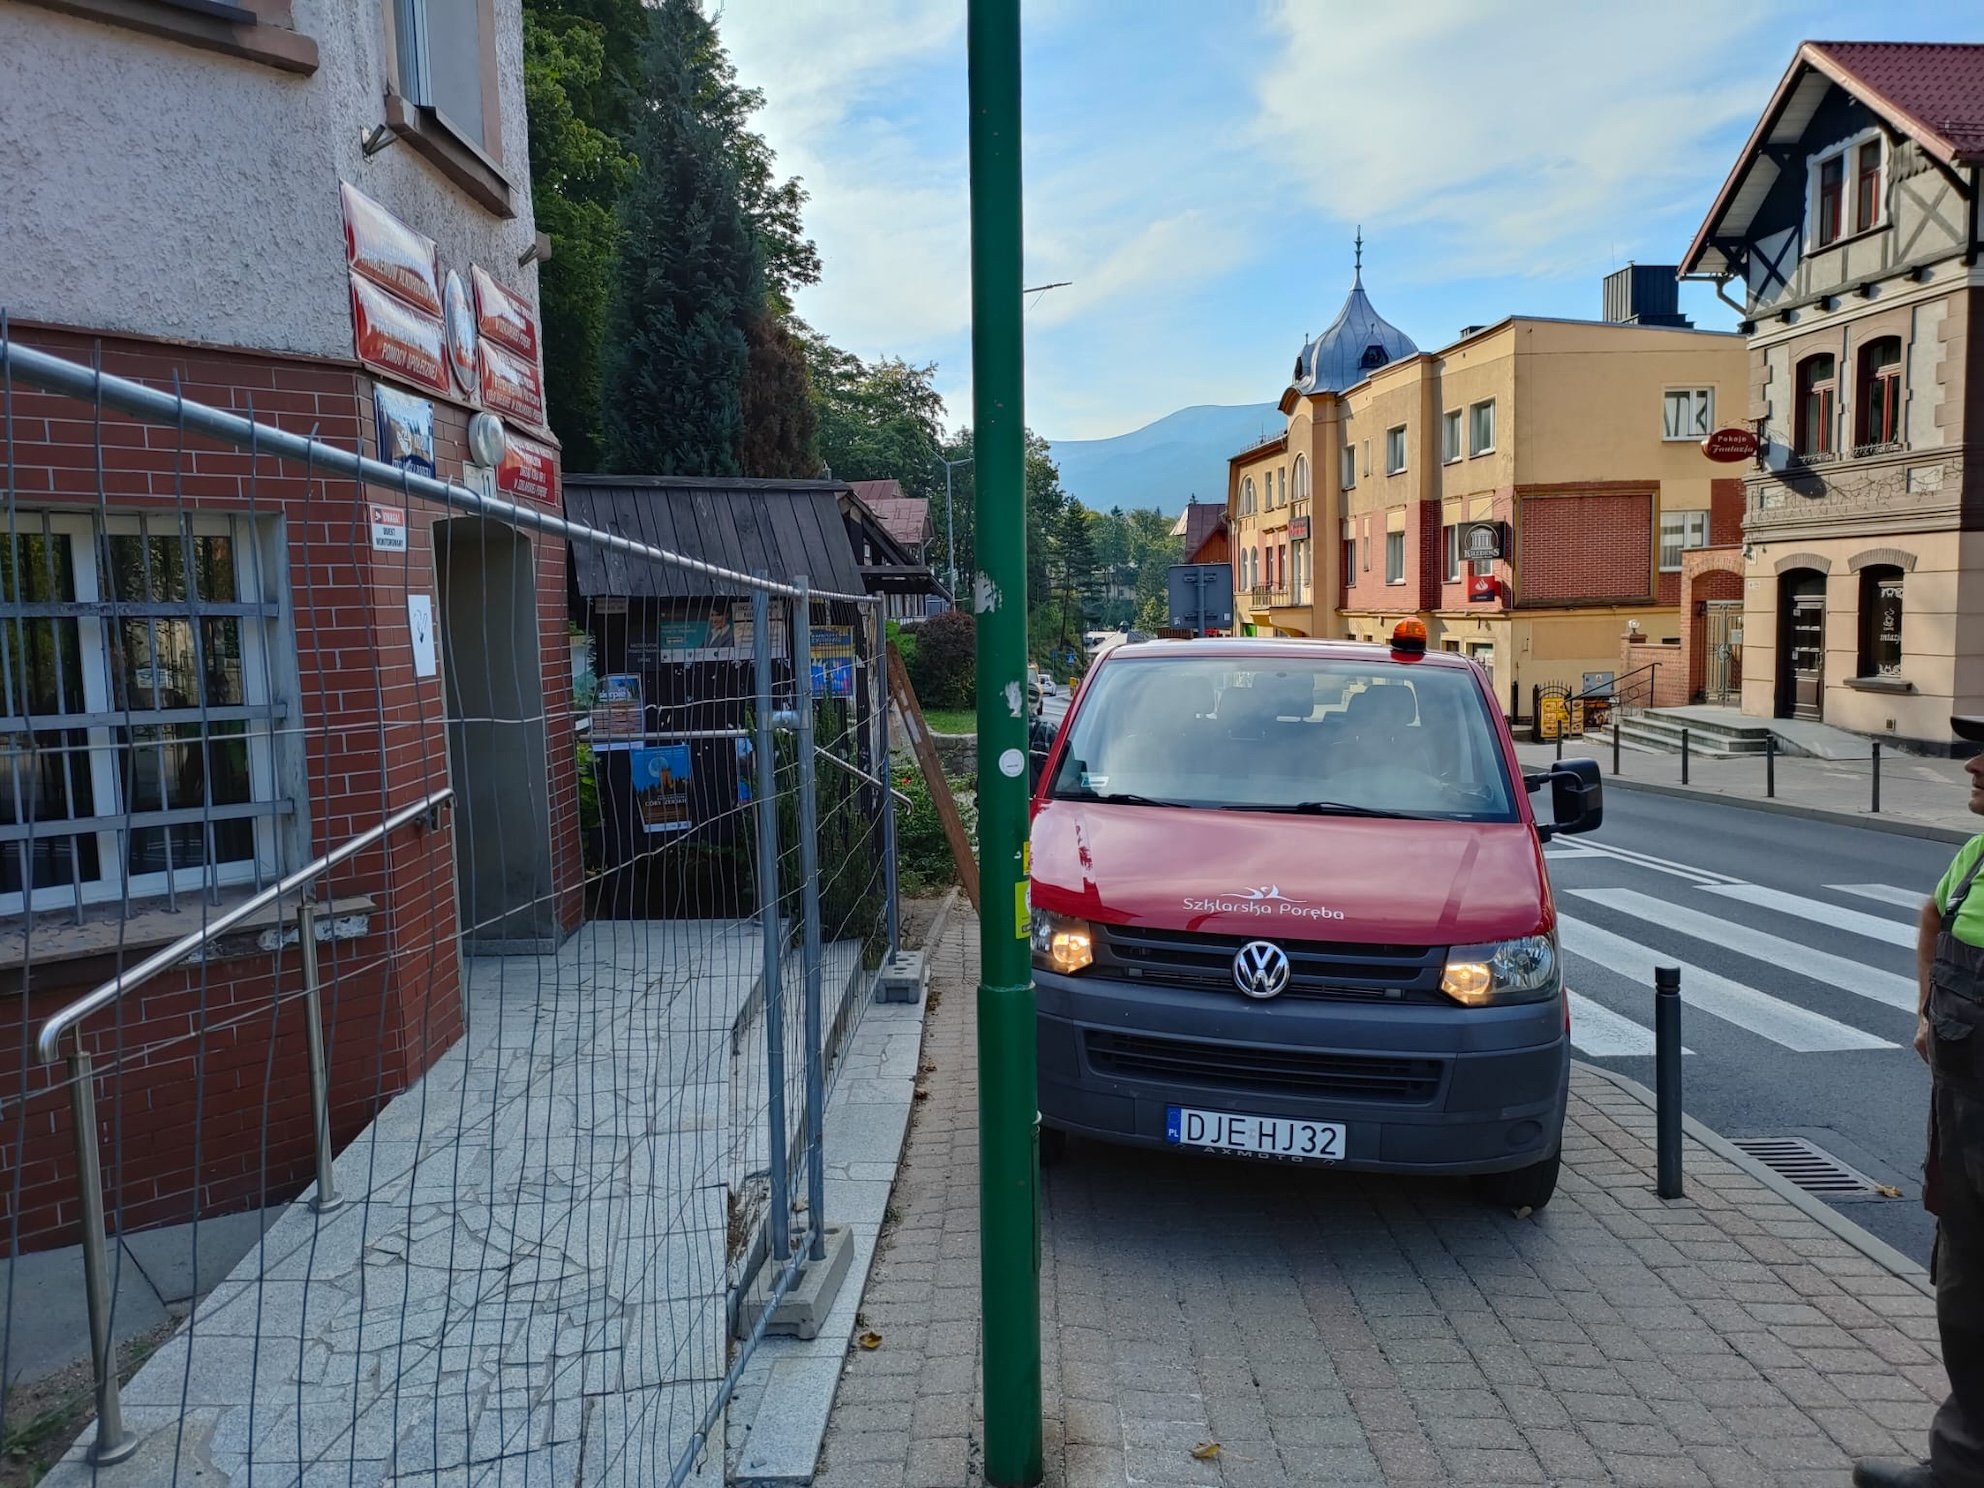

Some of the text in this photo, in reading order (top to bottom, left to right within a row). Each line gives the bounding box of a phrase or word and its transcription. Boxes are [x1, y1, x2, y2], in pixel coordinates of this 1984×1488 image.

[1712, 444, 1754, 454] Fantazja
[1183, 898, 1345, 920] Szklarska Poręba
[1168, 1128, 1179, 1138] PL
[1187, 1113, 1337, 1156] DJE HJ32
[1203, 1146, 1304, 1163] AXMOTO
